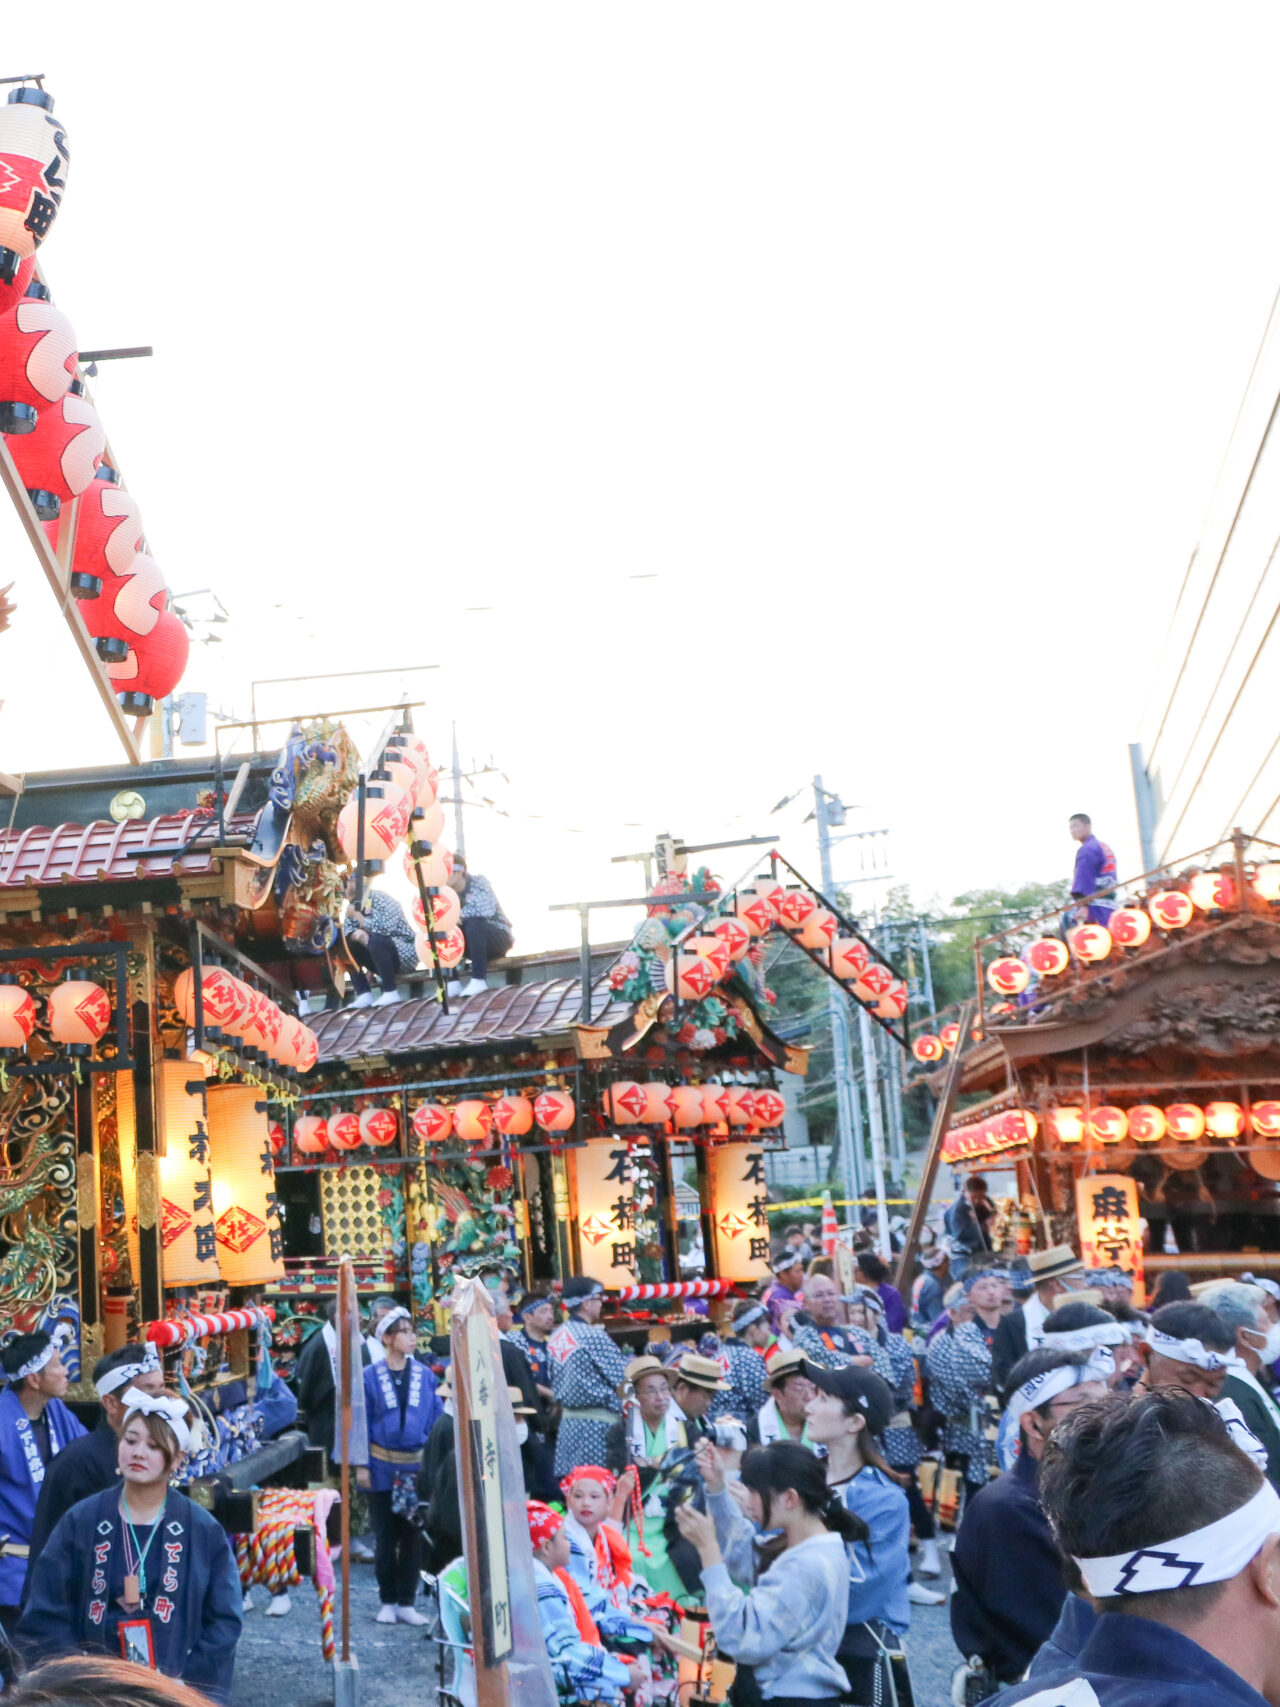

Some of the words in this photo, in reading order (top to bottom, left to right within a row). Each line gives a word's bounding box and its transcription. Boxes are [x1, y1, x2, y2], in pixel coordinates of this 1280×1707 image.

[1092, 1186, 1135, 1276] 麻苧
[88, 1541, 112, 1625] てら町
[153, 1541, 184, 1624] てら町
